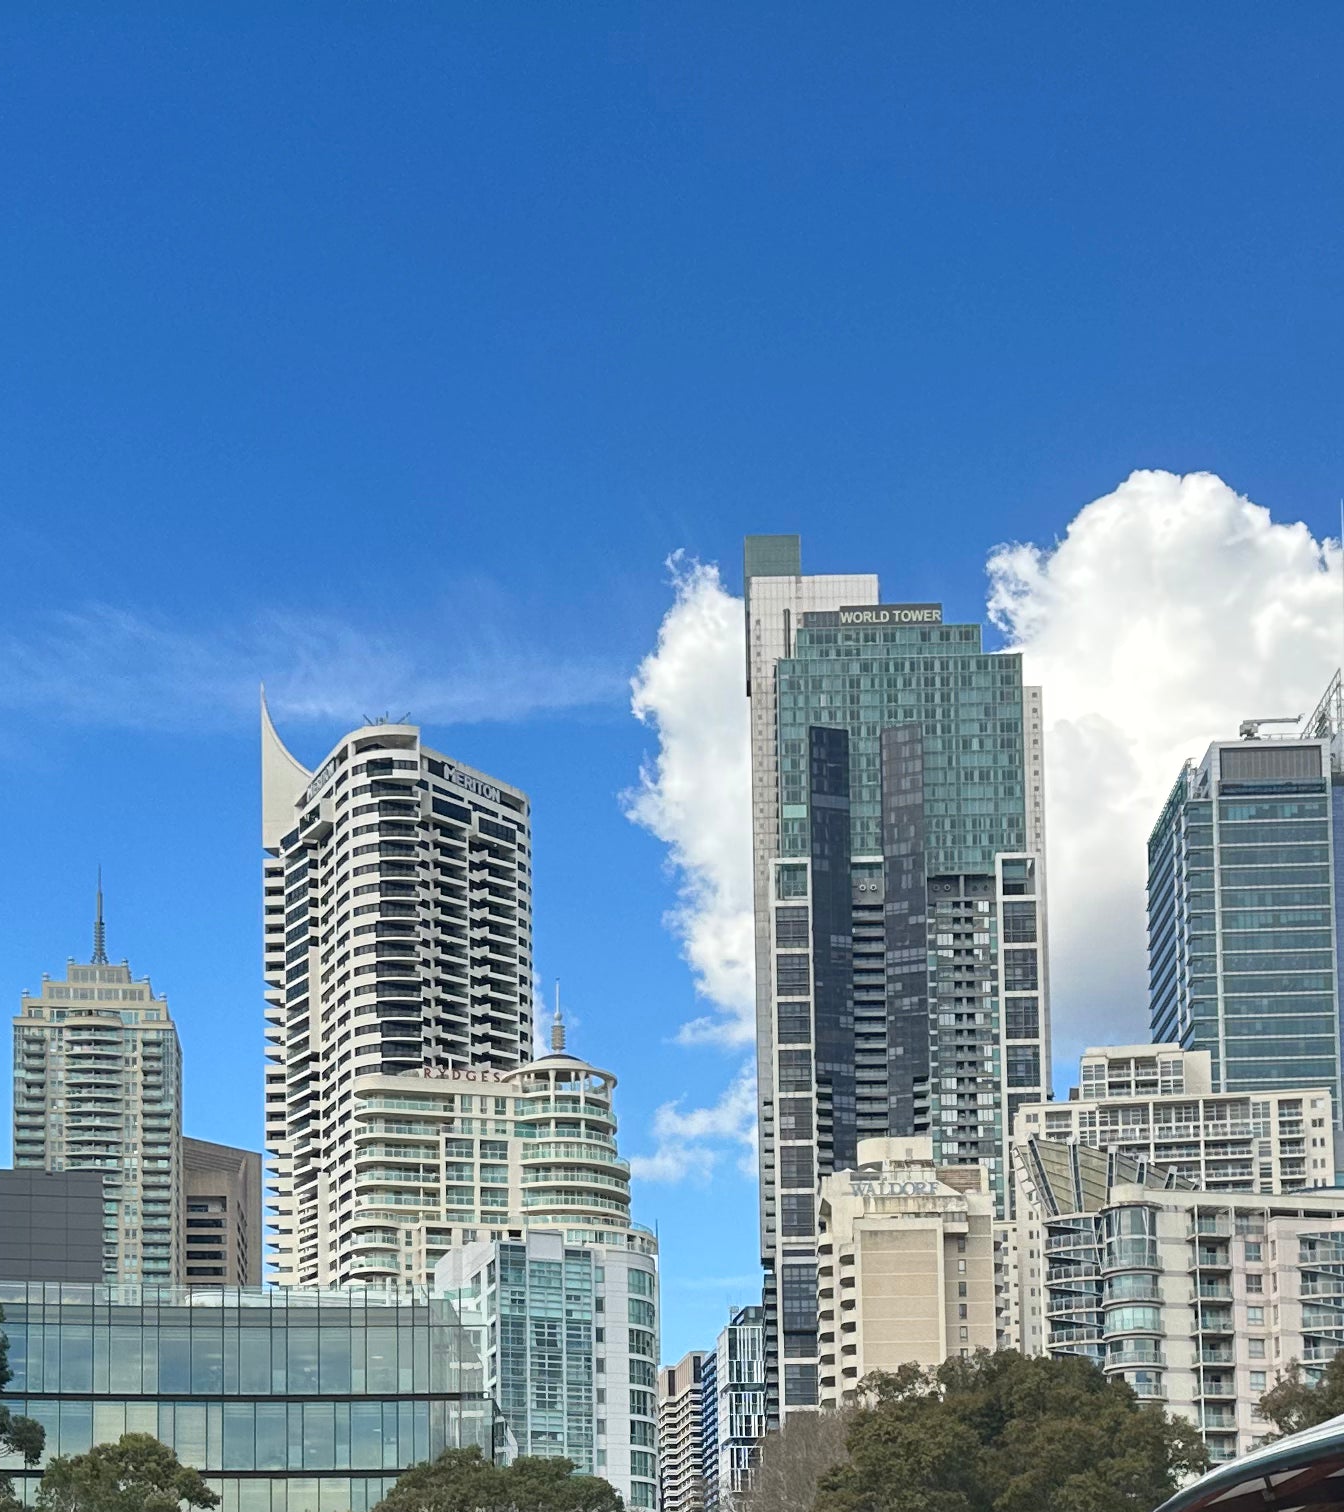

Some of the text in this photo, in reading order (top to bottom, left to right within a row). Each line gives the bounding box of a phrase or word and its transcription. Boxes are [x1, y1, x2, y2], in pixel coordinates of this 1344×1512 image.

[840, 610, 941, 623] WORLD TOWER
[444, 764, 500, 803] MERITON
[424, 1068, 500, 1082] RYDGES
[849, 1182, 940, 1196] WALDORF
